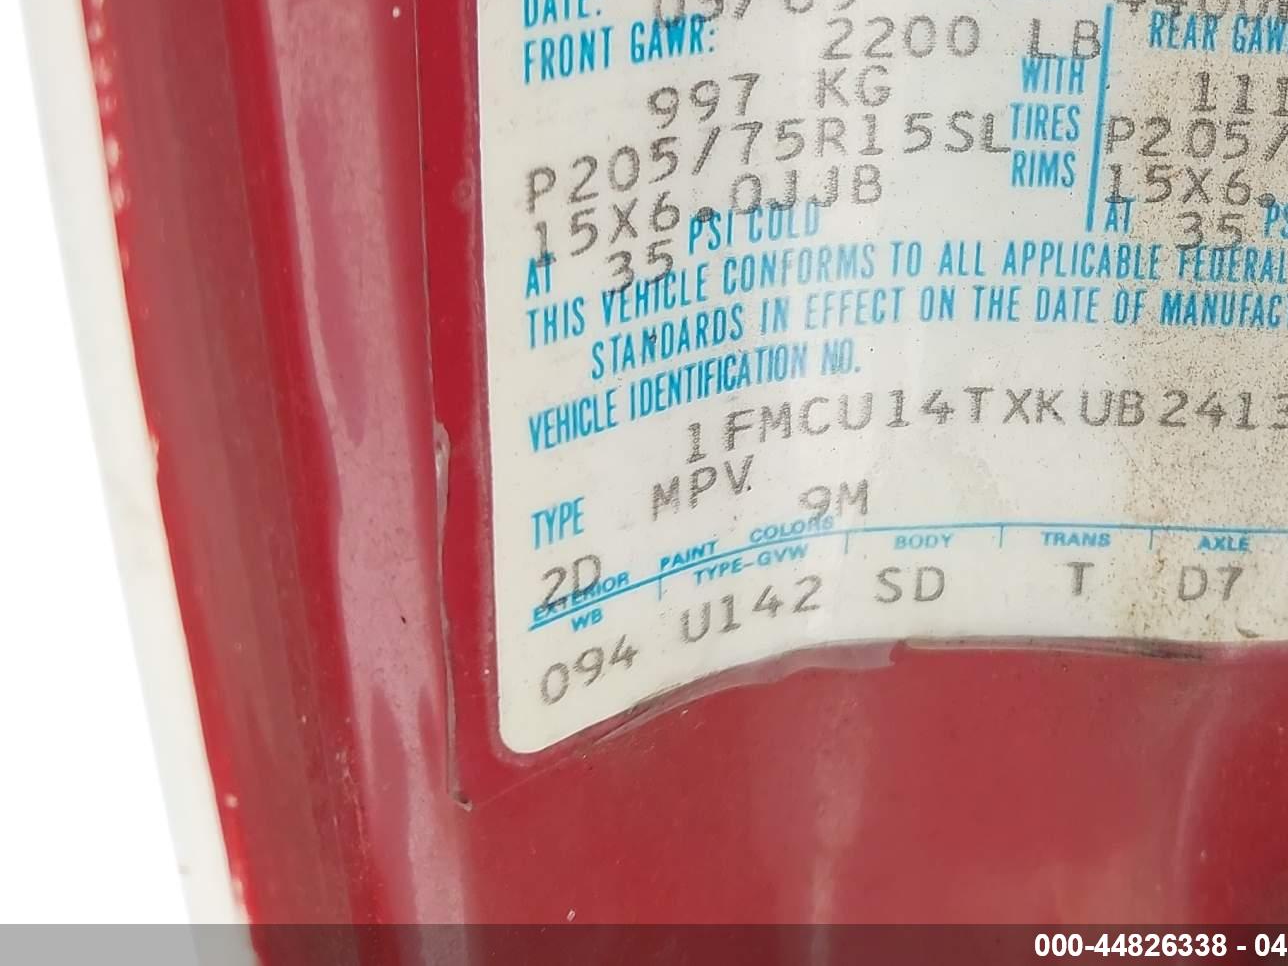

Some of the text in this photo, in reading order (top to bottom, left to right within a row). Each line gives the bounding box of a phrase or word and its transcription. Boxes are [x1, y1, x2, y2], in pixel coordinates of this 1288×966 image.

[522, 12, 1103, 86] FRONT GAWR: 2200 LB
[1148, 10, 1220, 51] REAR
[647, 56, 1085, 130] 997 KG WITH
[525, 102, 1081, 215] P205/75R15SL TIRES
[1010, 150, 1078, 190] RIMS
[524, 201, 821, 299] AT 35 PSI COLD
[1104, 197, 1135, 234] AT
[1176, 212, 1246, 251] 35
[525, 296, 586, 350] THIS
[602, 262, 711, 328] VEHICLE
[722, 243, 877, 296] CONFORMS
[890, 243, 922, 275] TO
[939, 242, 987, 276] ALL
[1002, 242, 1161, 282] APPLICABLE
[1177, 243, 1288, 284] FEDERAL
[590, 301, 745, 381] STANDARDS
[760, 295, 789, 333] IN
[803, 285, 902, 331] EFFECT
[919, 286, 954, 321] ON
[972, 285, 1020, 321] THE
[1035, 286, 1100, 325] DATE
[1113, 287, 1148, 324] OF
[528, 338, 861, 452] VEHICLE IDENTIFICATION NO.
[531, 496, 585, 551] TYPE
[799, 478, 869, 518] 9M
[692, 542, 809, 587] TYPE-GVW
[894, 532, 955, 549] BODY
[1042, 531, 1111, 548] TRANS
[1198, 536, 1250, 553] AXLE
[532, 514, 835, 622] EXTERIOR PAINT COLORS
[541, 554, 602, 610] 2D
[875, 564, 946, 604] SD
[1065, 561, 1094, 597] T
[1177, 564, 1244, 602] D7
[571, 607, 604, 633] WB
[679, 575, 822, 644] U142
[539, 632, 638, 707] 094
